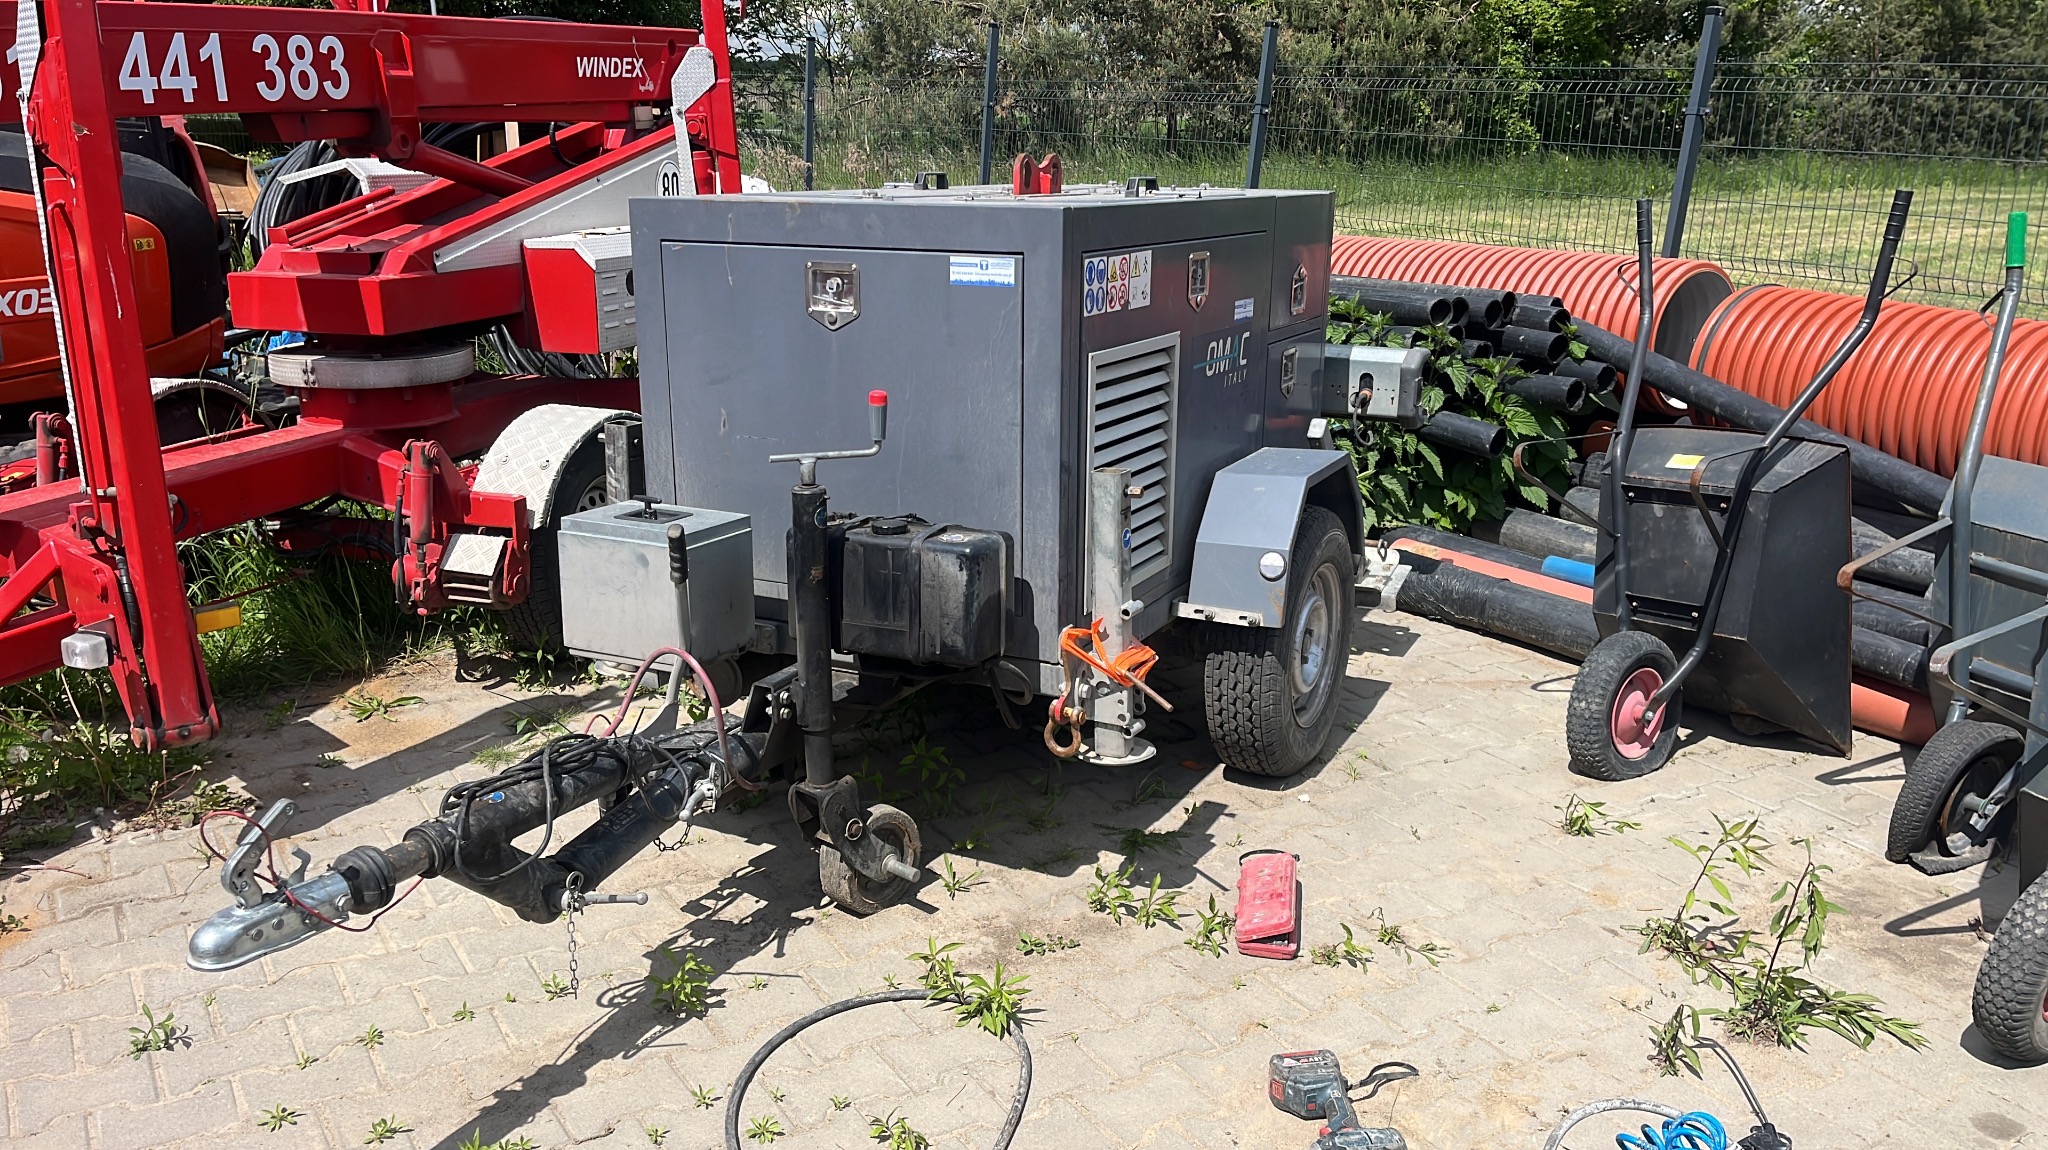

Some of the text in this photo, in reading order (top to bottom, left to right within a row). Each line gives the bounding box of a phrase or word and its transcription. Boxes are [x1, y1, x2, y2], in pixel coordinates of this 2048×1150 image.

[118, 31, 350, 104] 441 383
[576, 56, 644, 78] WINDEX
[662, 171, 680, 197] 80
[1204, 331, 1251, 377] OMAC
[1223, 368, 1248, 388] ITALY
